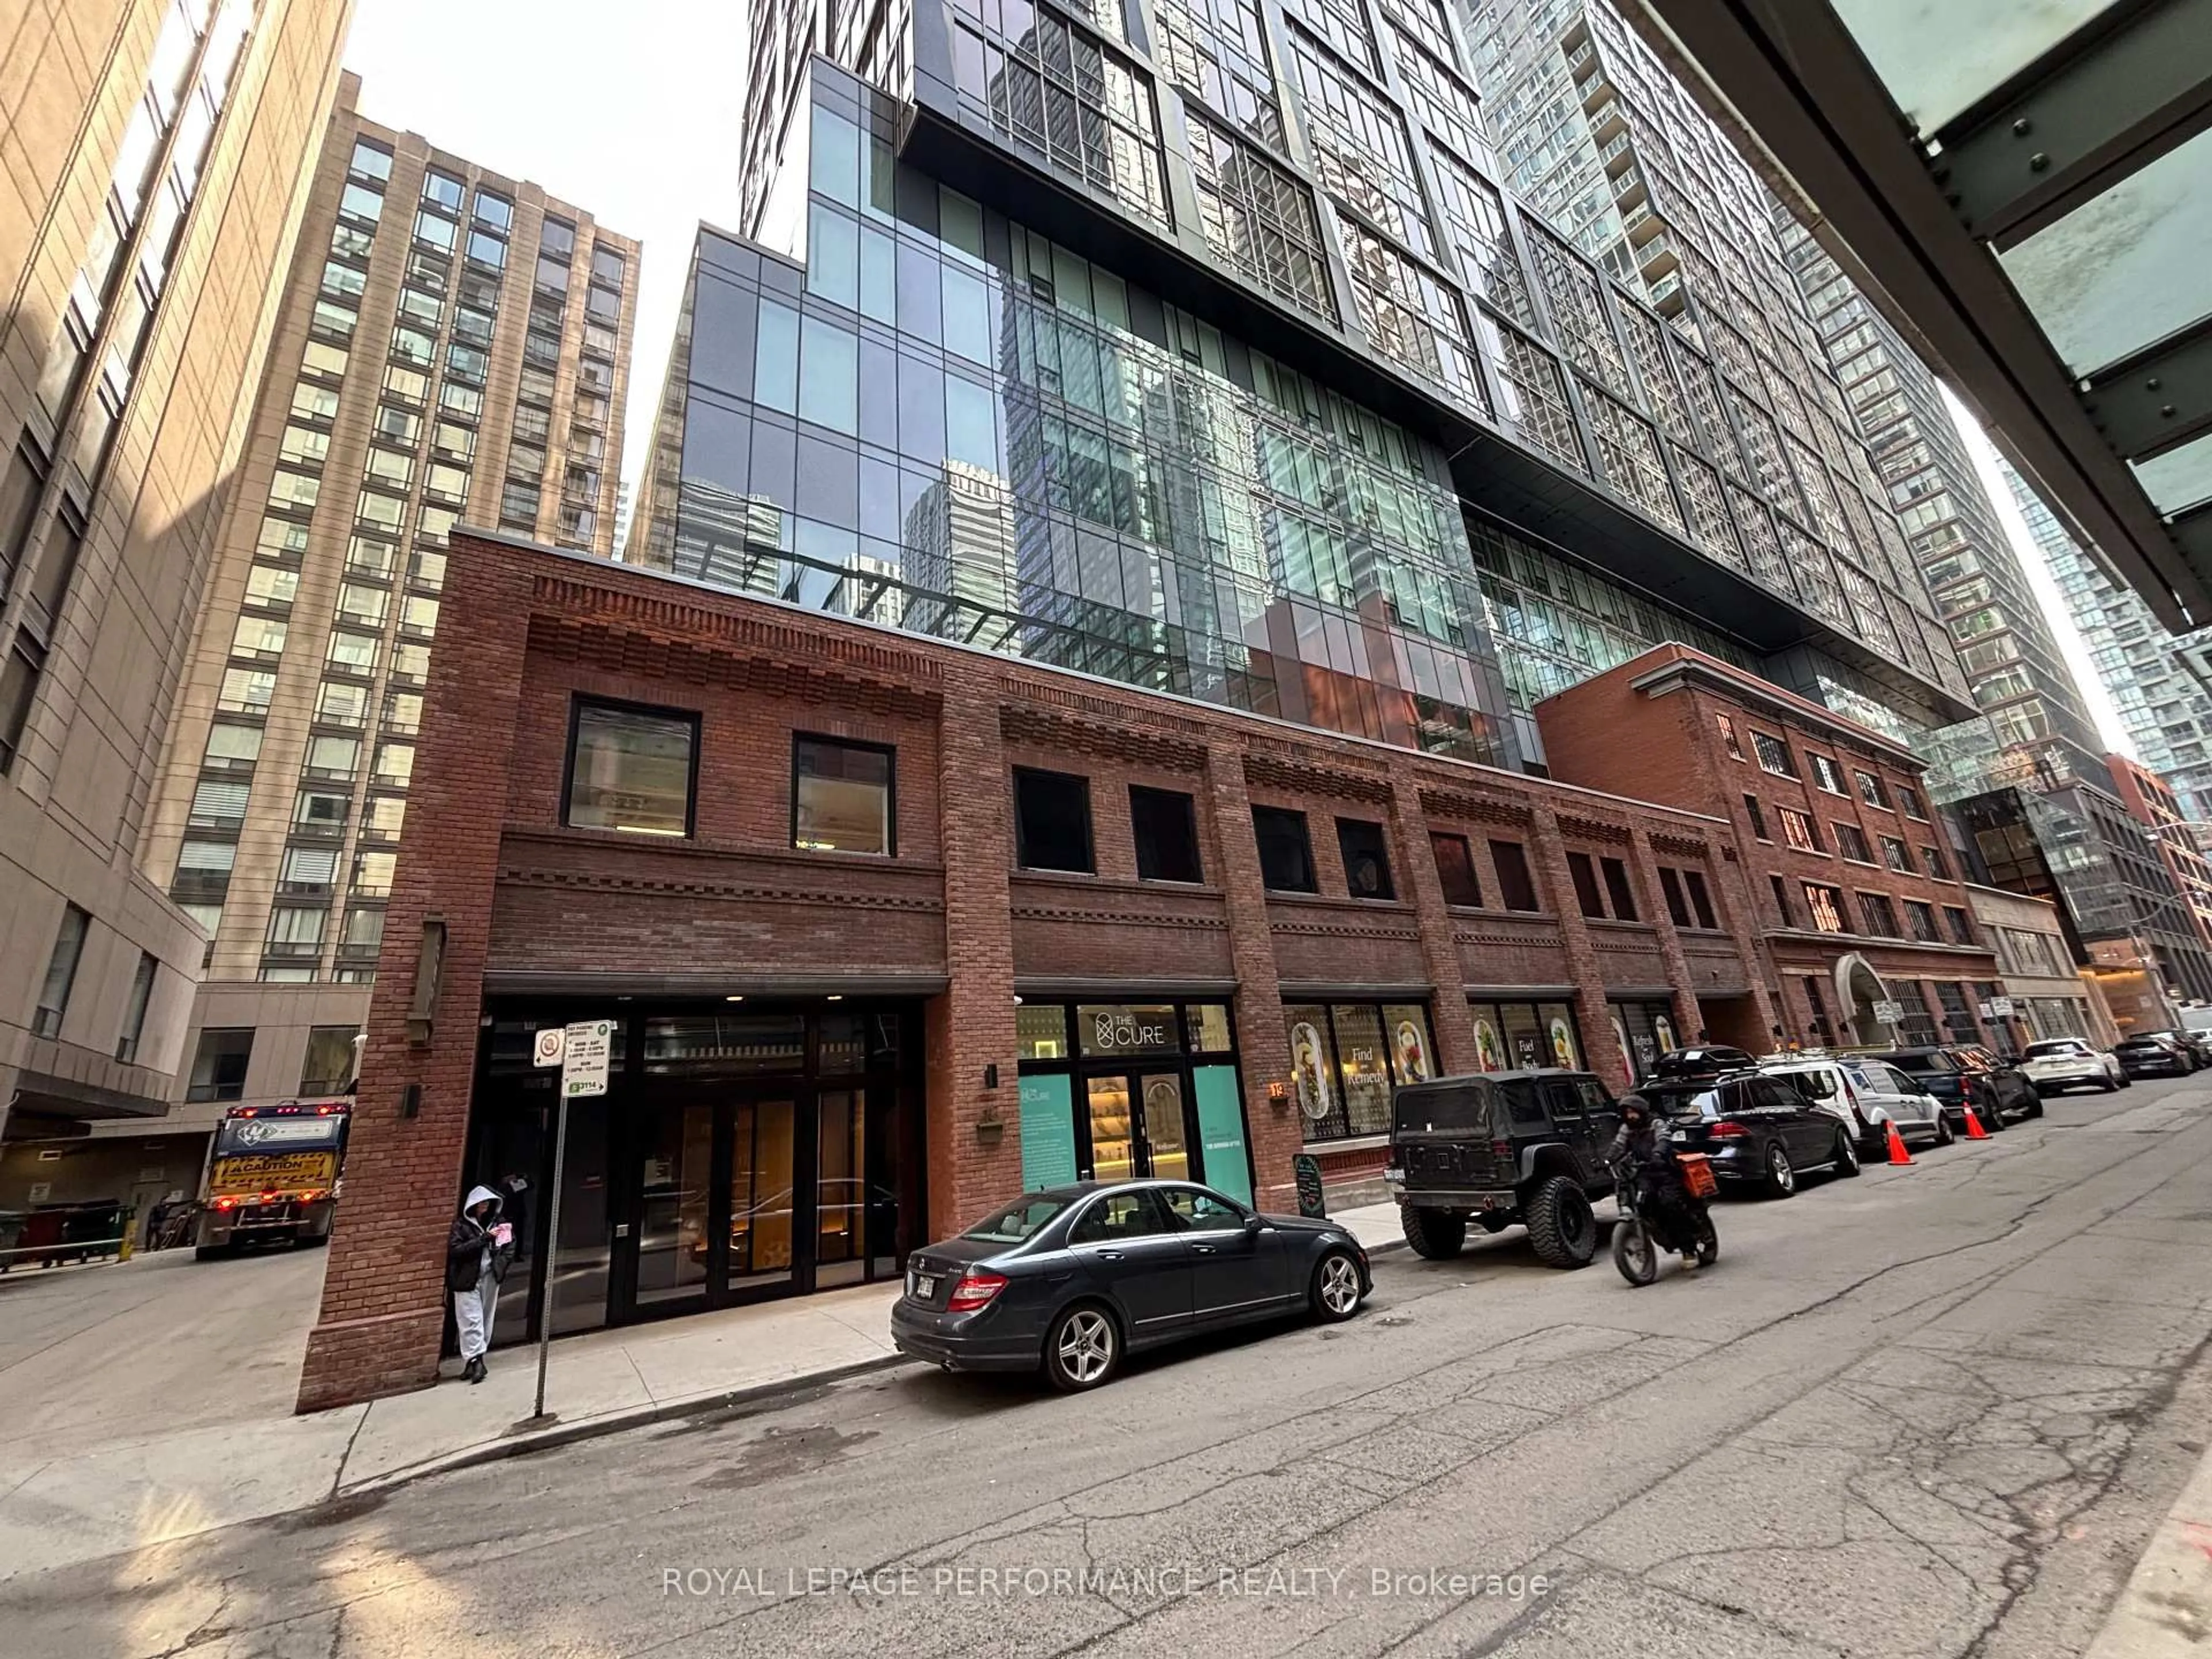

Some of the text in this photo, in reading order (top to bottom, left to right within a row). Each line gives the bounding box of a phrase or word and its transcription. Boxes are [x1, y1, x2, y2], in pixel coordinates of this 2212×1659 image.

[1115, 1016, 1132, 1025] THE
[1116, 1025, 1165, 1045] CURE
[1352, 1047, 1373, 1060] Find
[1348, 1069, 1384, 1088] Remedy
[243, 1160, 302, 1172] CAUTION
